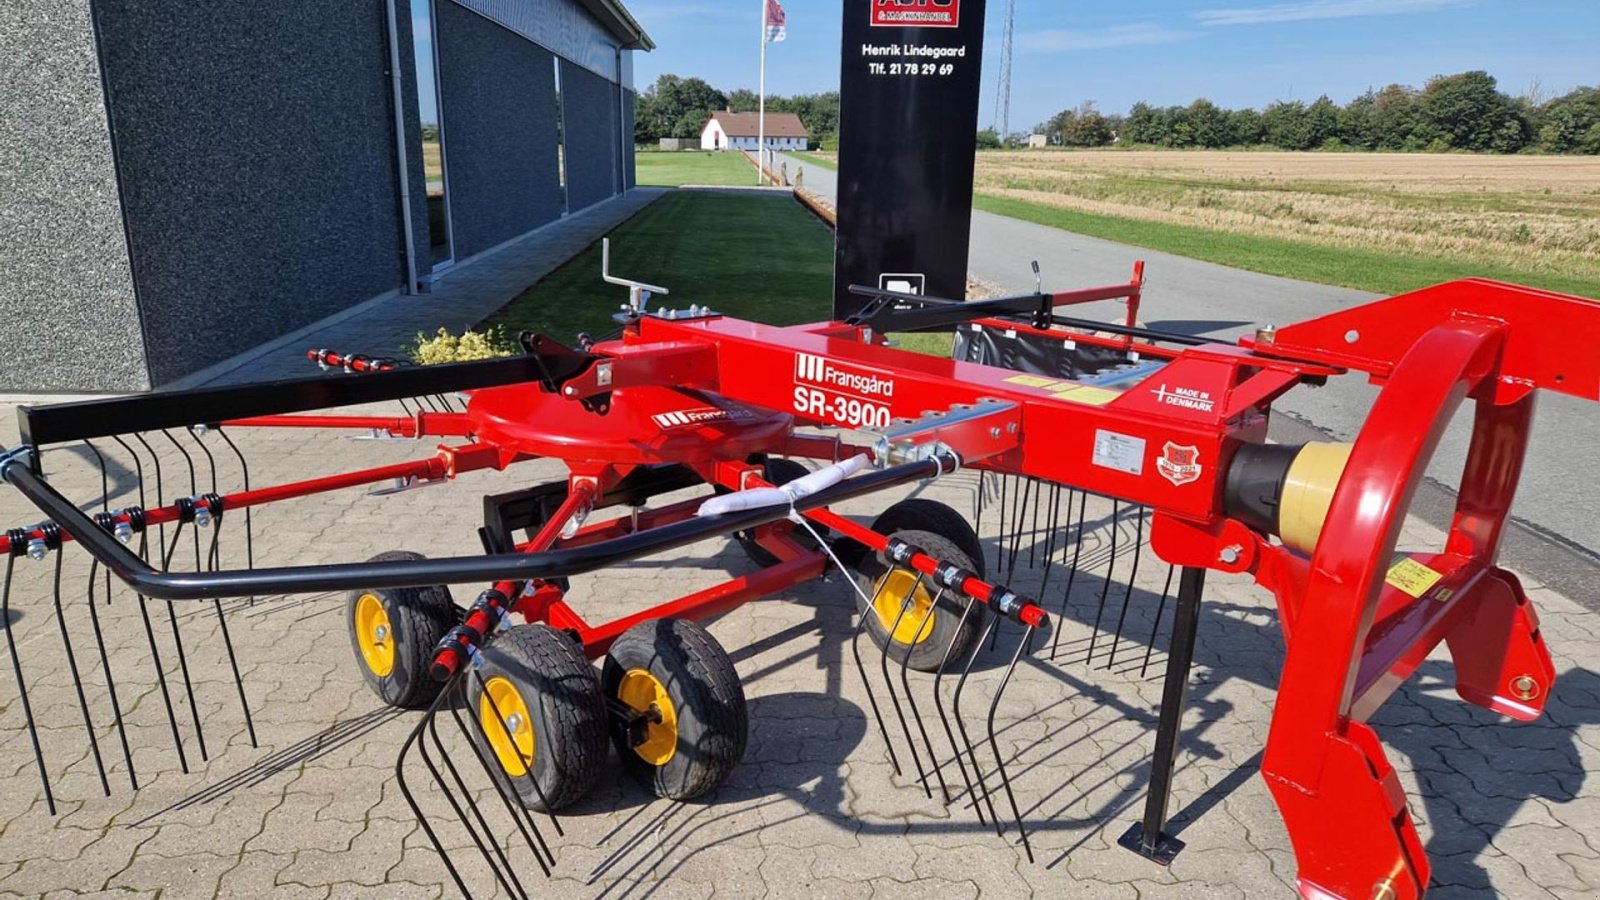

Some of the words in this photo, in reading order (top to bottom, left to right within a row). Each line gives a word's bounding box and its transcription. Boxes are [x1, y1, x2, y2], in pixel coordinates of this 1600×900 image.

[886, 11, 952, 22] MASKINHANDEL
[862, 44, 901, 56] Henrik
[903, 44, 966, 59] Lindegaard
[869, 63, 887, 75] Tlf.
[889, 63, 901, 75] 21
[904, 63, 919, 75] 78
[921, 63, 937, 75] 29
[939, 64, 954, 76] 69
[825, 367, 894, 397] Fransgård
[1175, 387, 1198, 398] MADE
[1200, 391, 1210, 400] IN
[793, 386, 891, 427] SR-3900
[1165, 396, 1214, 413] DENMARK
